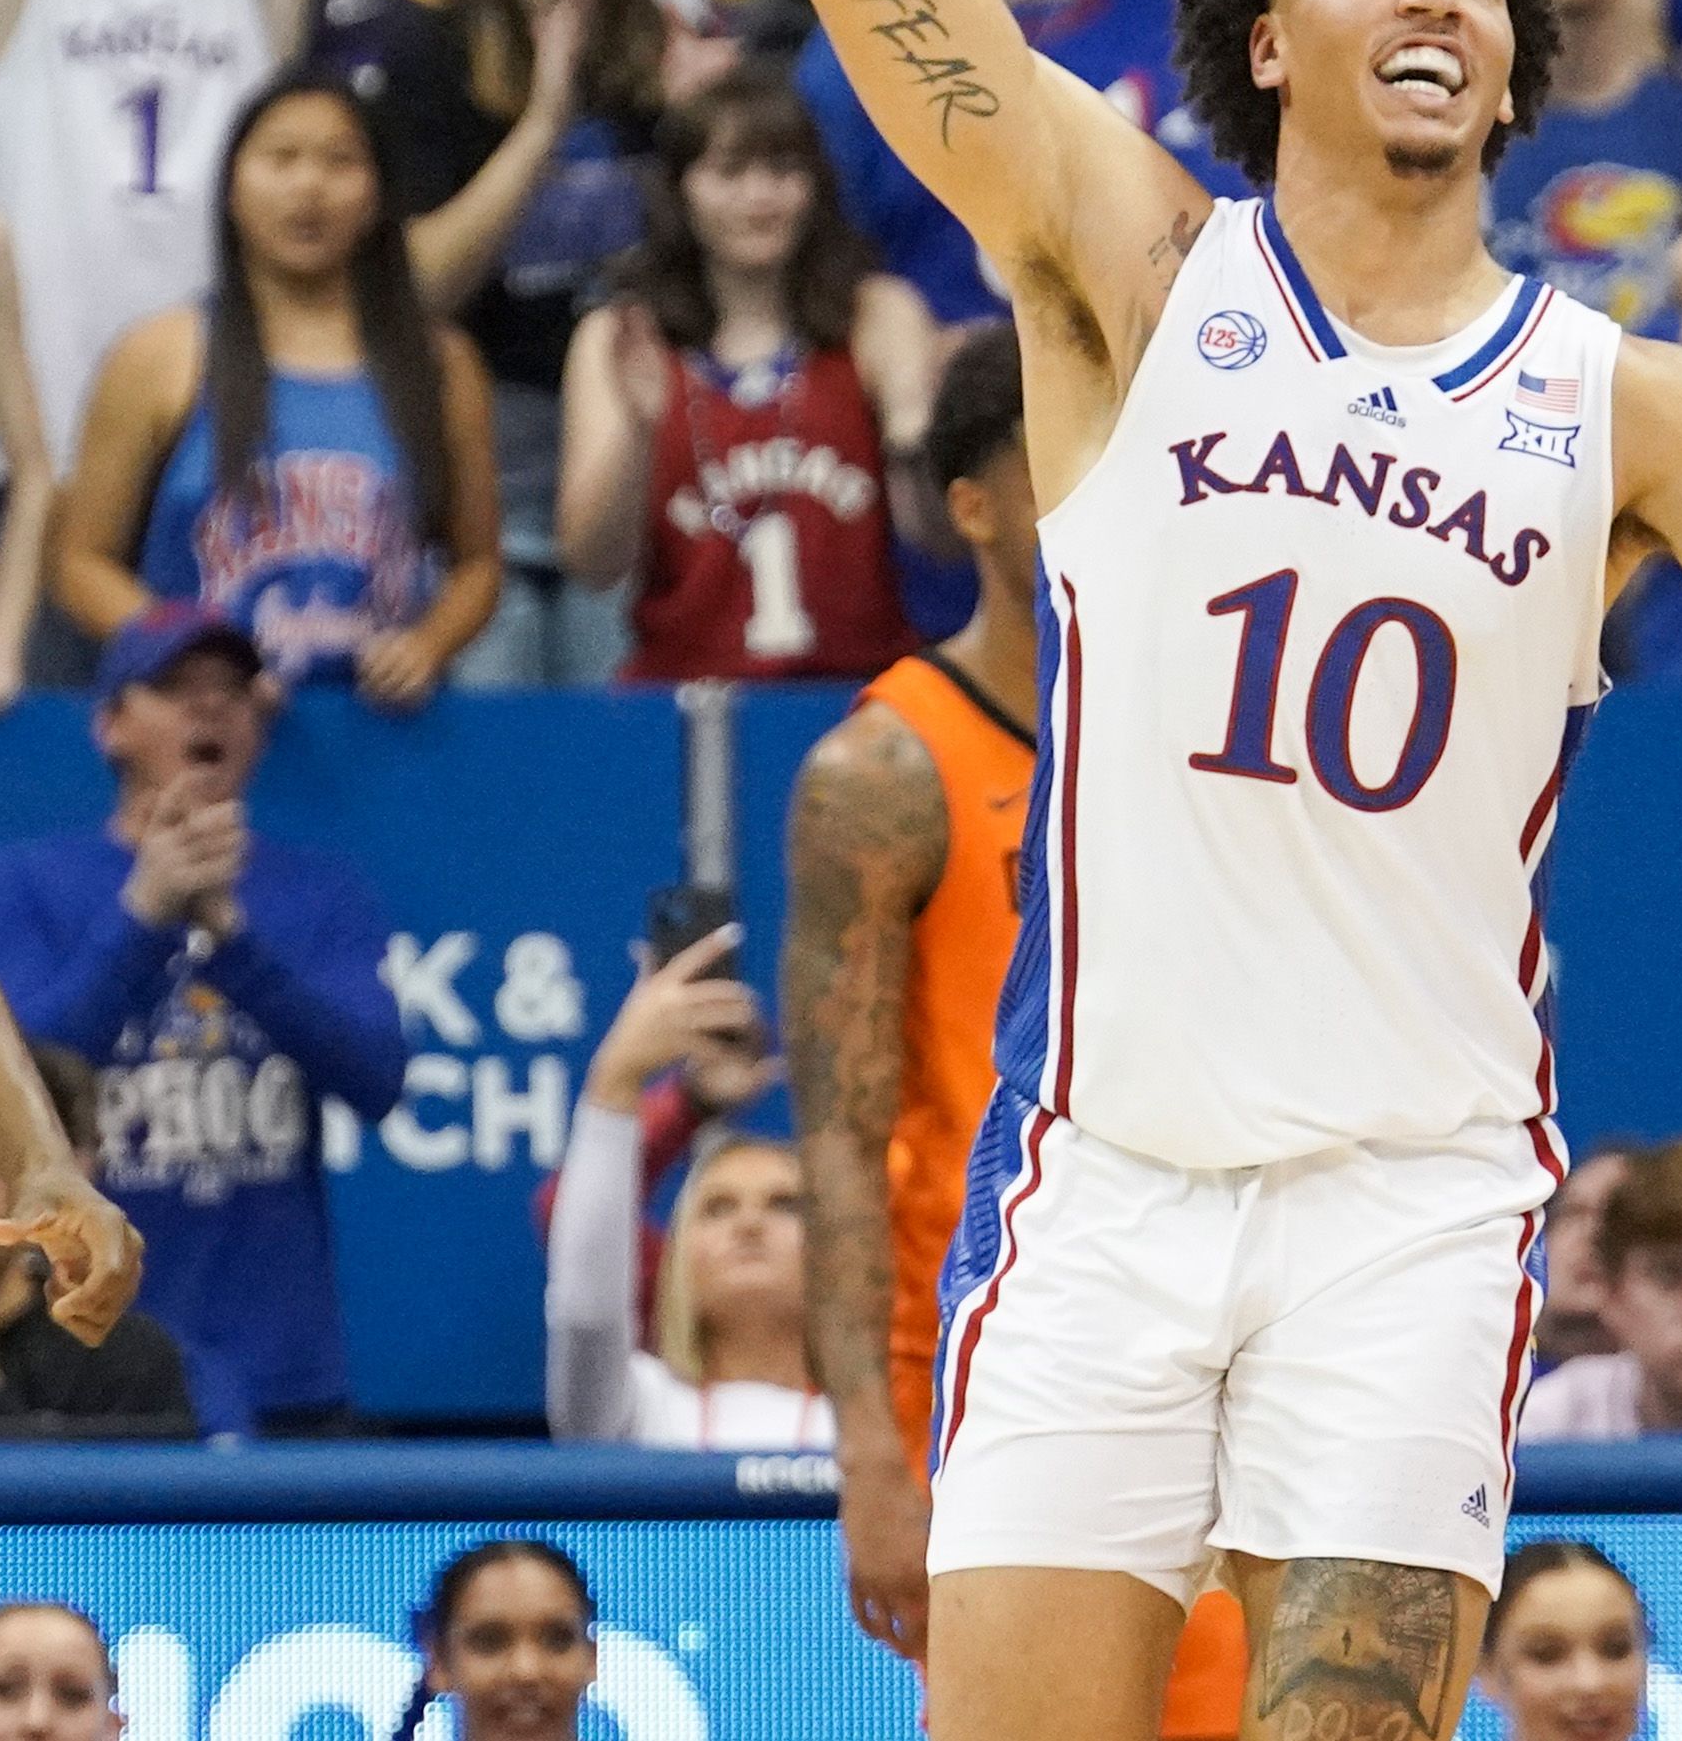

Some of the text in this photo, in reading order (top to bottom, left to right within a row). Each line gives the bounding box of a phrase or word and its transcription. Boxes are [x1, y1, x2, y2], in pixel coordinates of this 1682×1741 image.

[116, 78, 169, 197] 1
[1204, 326, 1239, 350] 125
[1347, 401, 1407, 429] adidas
[1167, 430, 1551, 586] KANSAS
[738, 511, 818, 656] 1
[1187, 568, 1458, 813] 10
[494, 929, 587, 1044] &
